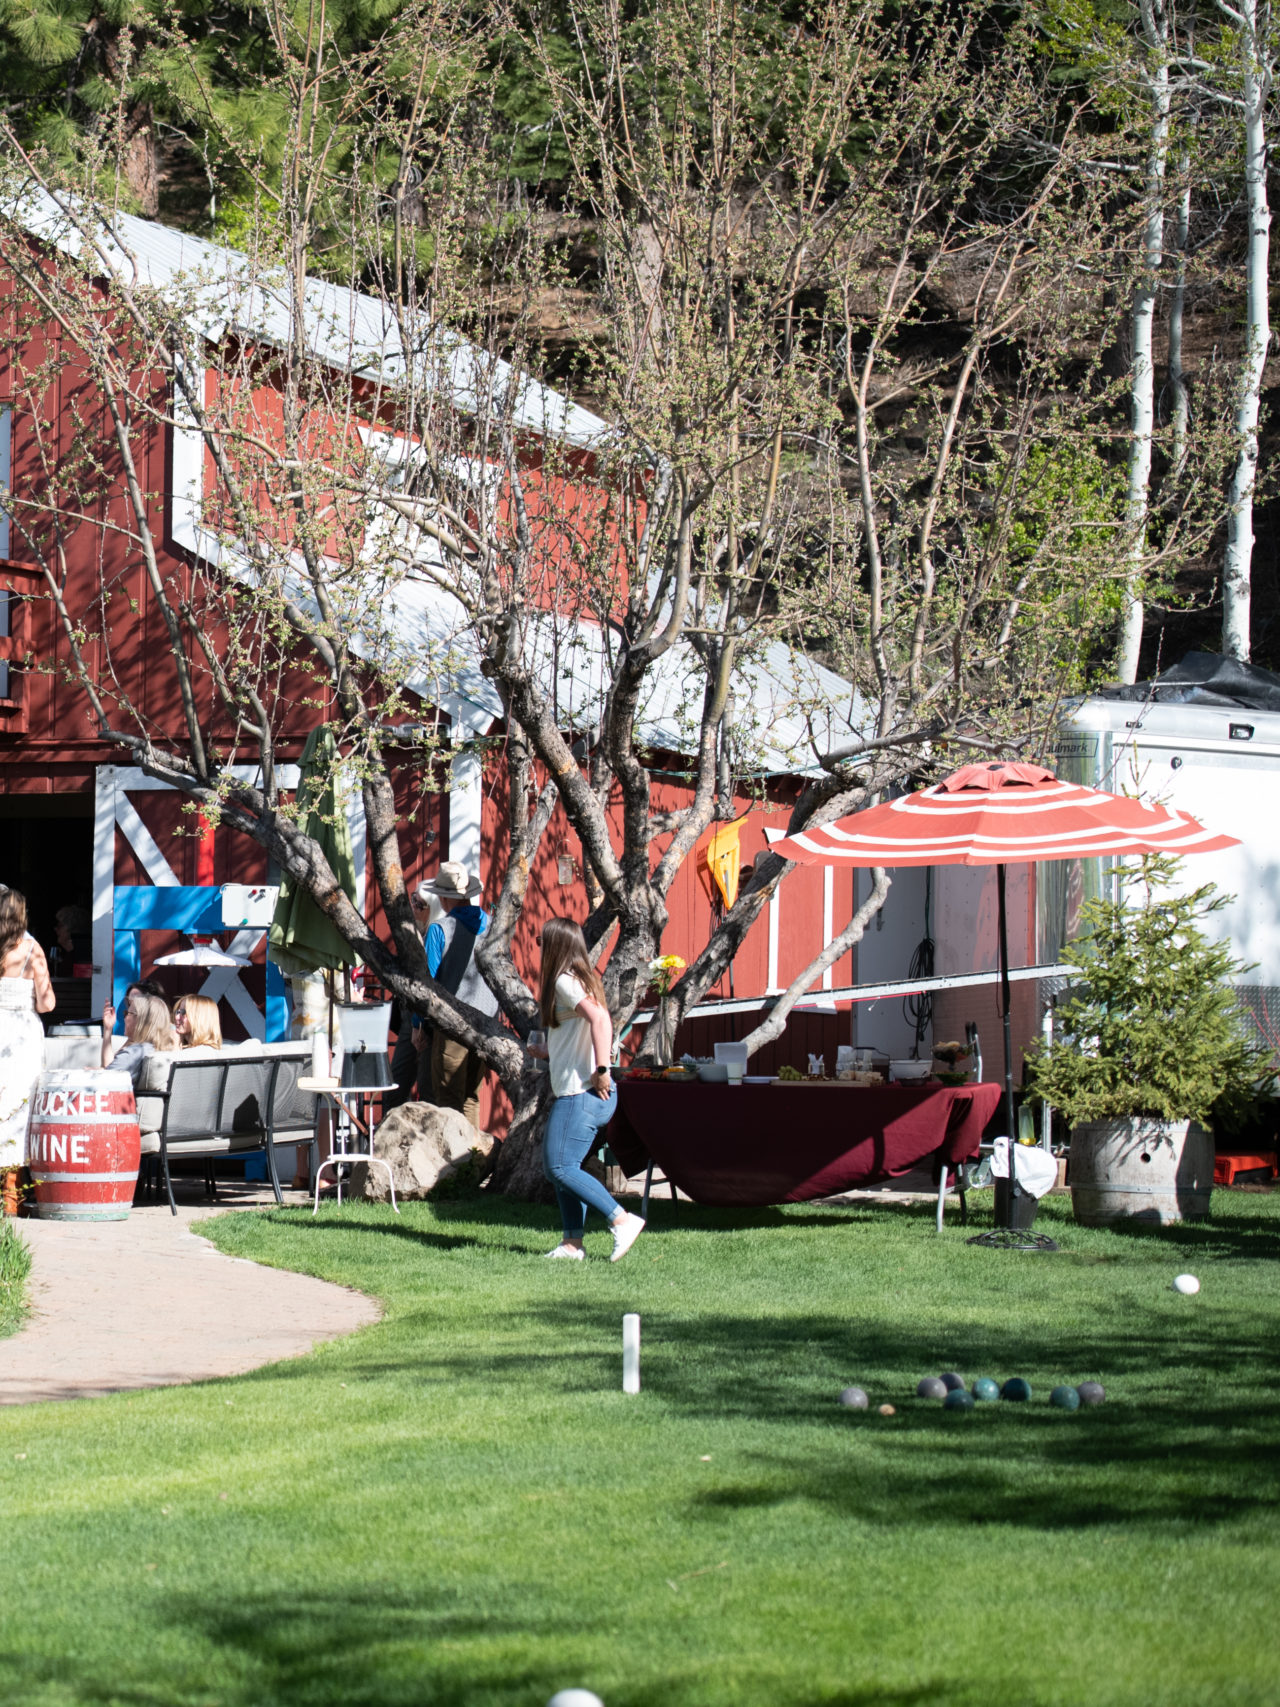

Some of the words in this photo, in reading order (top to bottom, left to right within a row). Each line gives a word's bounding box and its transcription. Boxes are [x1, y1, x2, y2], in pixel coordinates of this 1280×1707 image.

[1046, 742, 1088, 754] aulmark
[35, 1090, 112, 1116] RUCKEE
[30, 1133, 90, 1164] WINE
